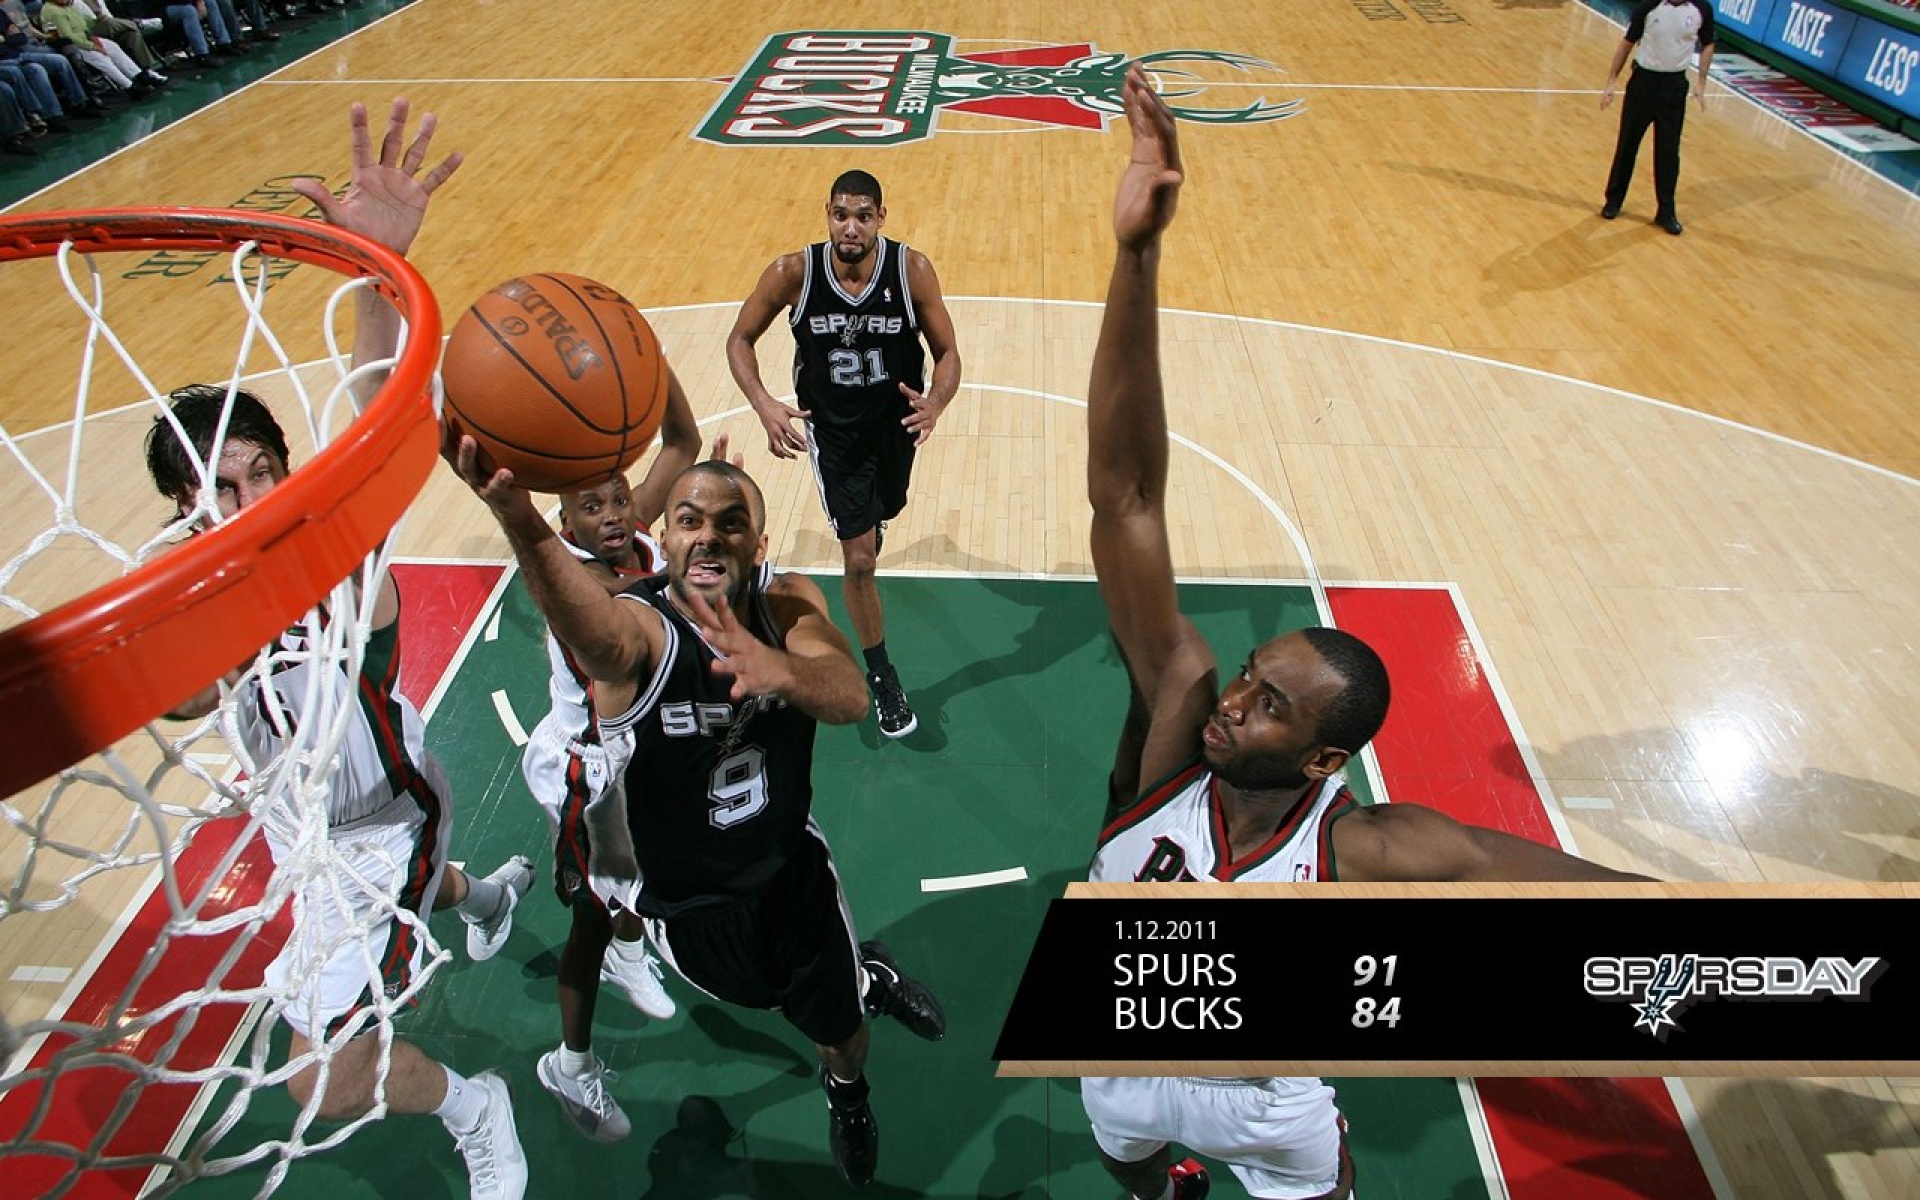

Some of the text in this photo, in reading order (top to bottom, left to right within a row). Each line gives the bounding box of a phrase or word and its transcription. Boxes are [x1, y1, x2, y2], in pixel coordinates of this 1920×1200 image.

[720, 33, 935, 138] BUCKS
[895, 53, 940, 115] MILWAUKEE
[1864, 38, 1920, 97] LESS
[808, 312, 903, 341] SPURS
[828, 348, 890, 387] 21
[707, 743, 770, 830] 9
